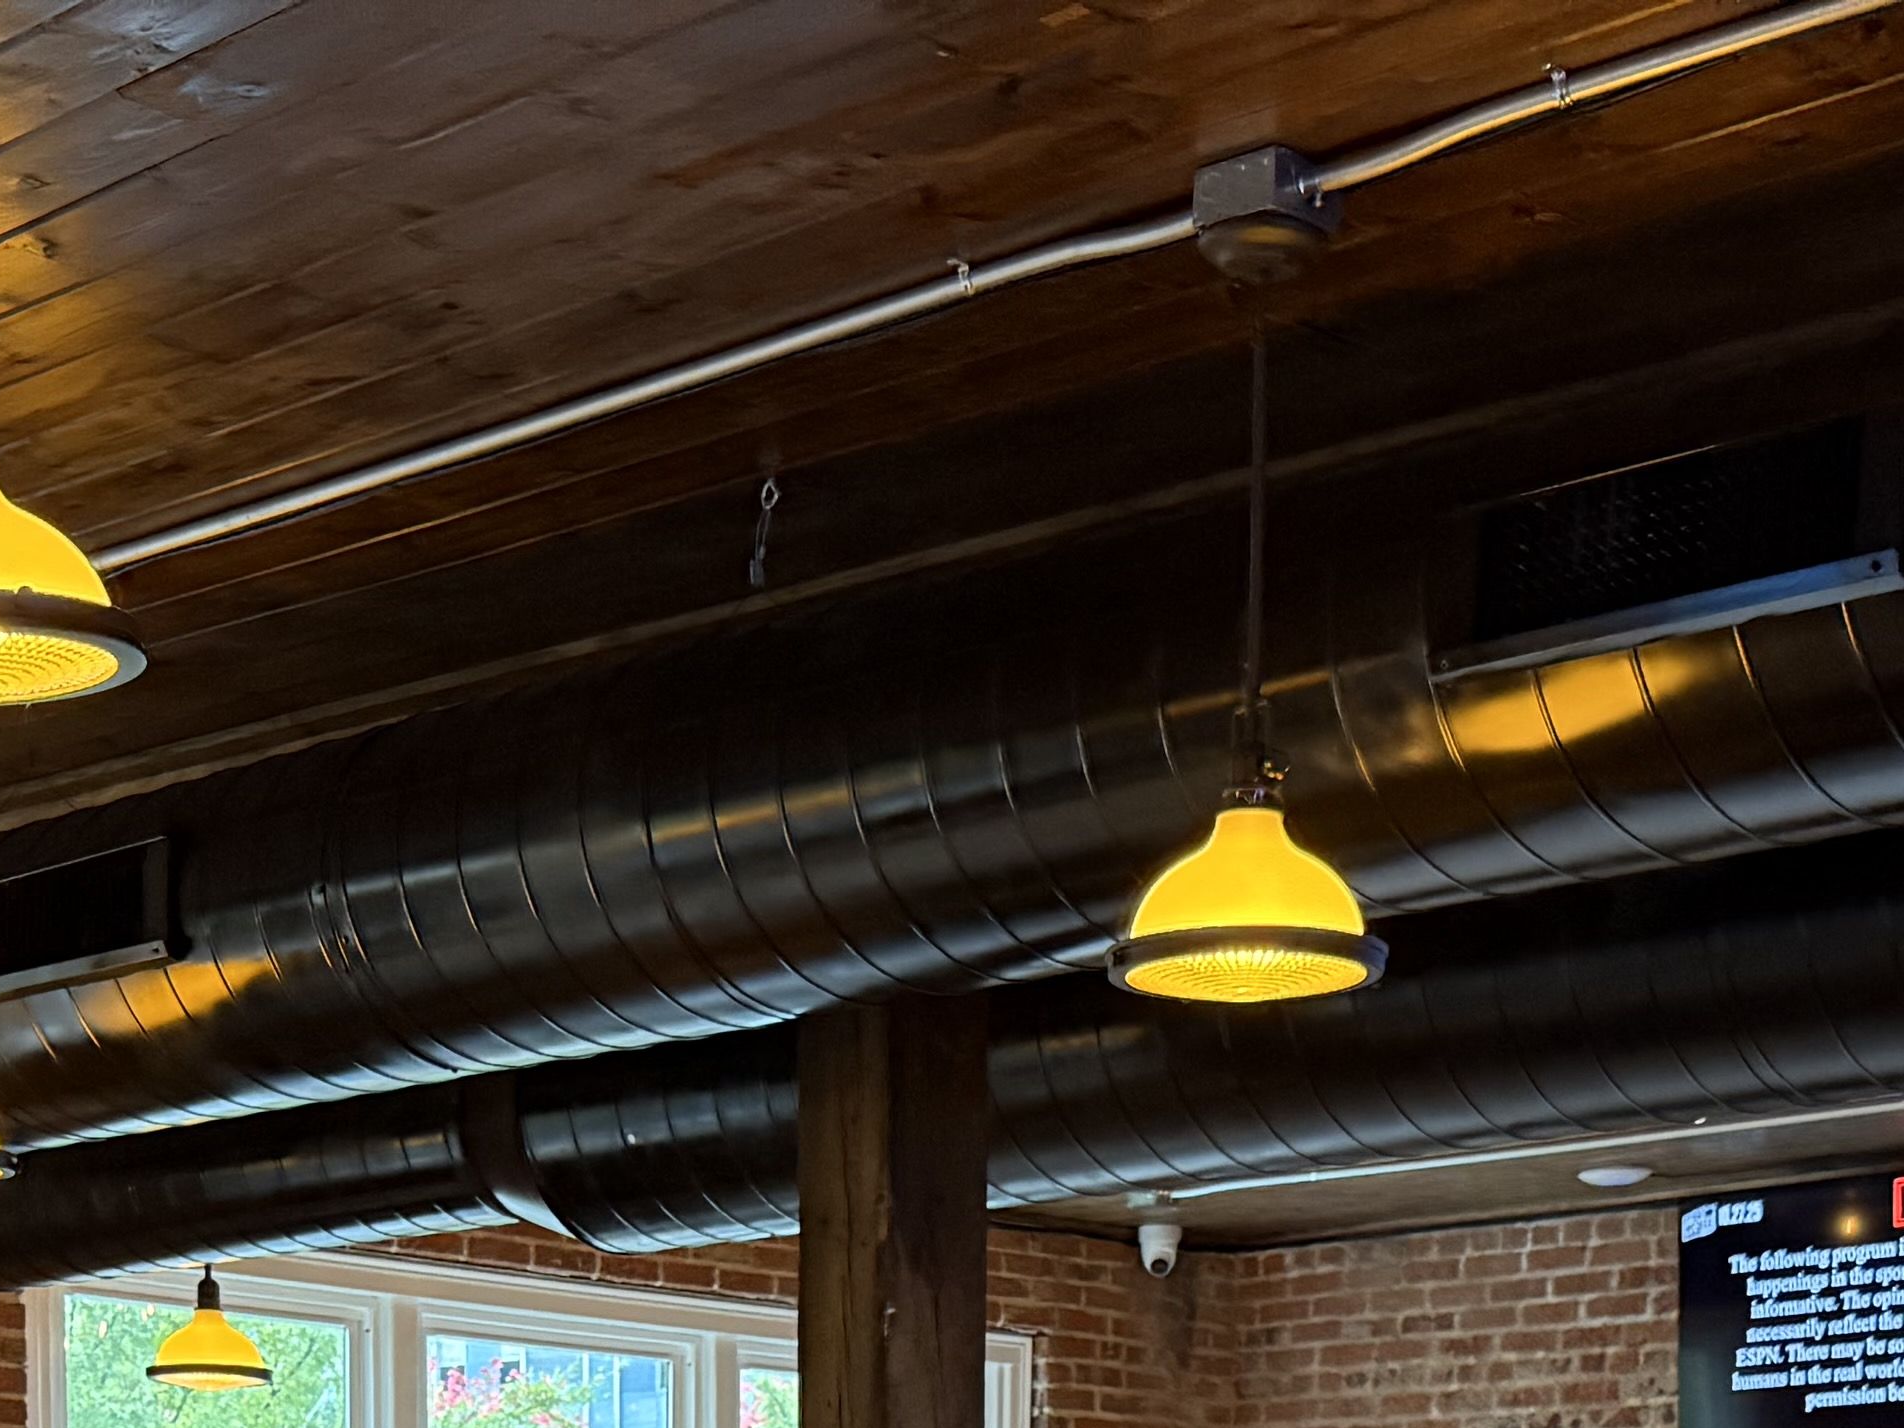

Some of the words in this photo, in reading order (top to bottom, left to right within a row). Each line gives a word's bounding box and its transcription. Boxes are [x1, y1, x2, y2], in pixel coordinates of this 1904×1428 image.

[1728, 1252, 1758, 1274] The
[1759, 1245, 1831, 1272] following
[1747, 1271, 1829, 1299] happenings
[1831, 1267, 1847, 1287] in
[1849, 1265, 1874, 1285] the
[1840, 1290, 1872, 1310] The
[1746, 1316, 1828, 1343] necessarily
[1828, 1313, 1877, 1335] reflect
[1879, 1309, 1903, 1330] the
[1735, 1343, 1786, 1368] ESPN.
[1785, 1341, 1830, 1363] There
[1831, 1340, 1865, 1361] may
[1866, 1336, 1886, 1356] be
[1731, 1370, 1789, 1392] humans
[1790, 1366, 1806, 1386] in
[1807, 1363, 1832, 1385] the
[1833, 1360, 1864, 1383] real
[1804, 1383, 1886, 1413] permission
